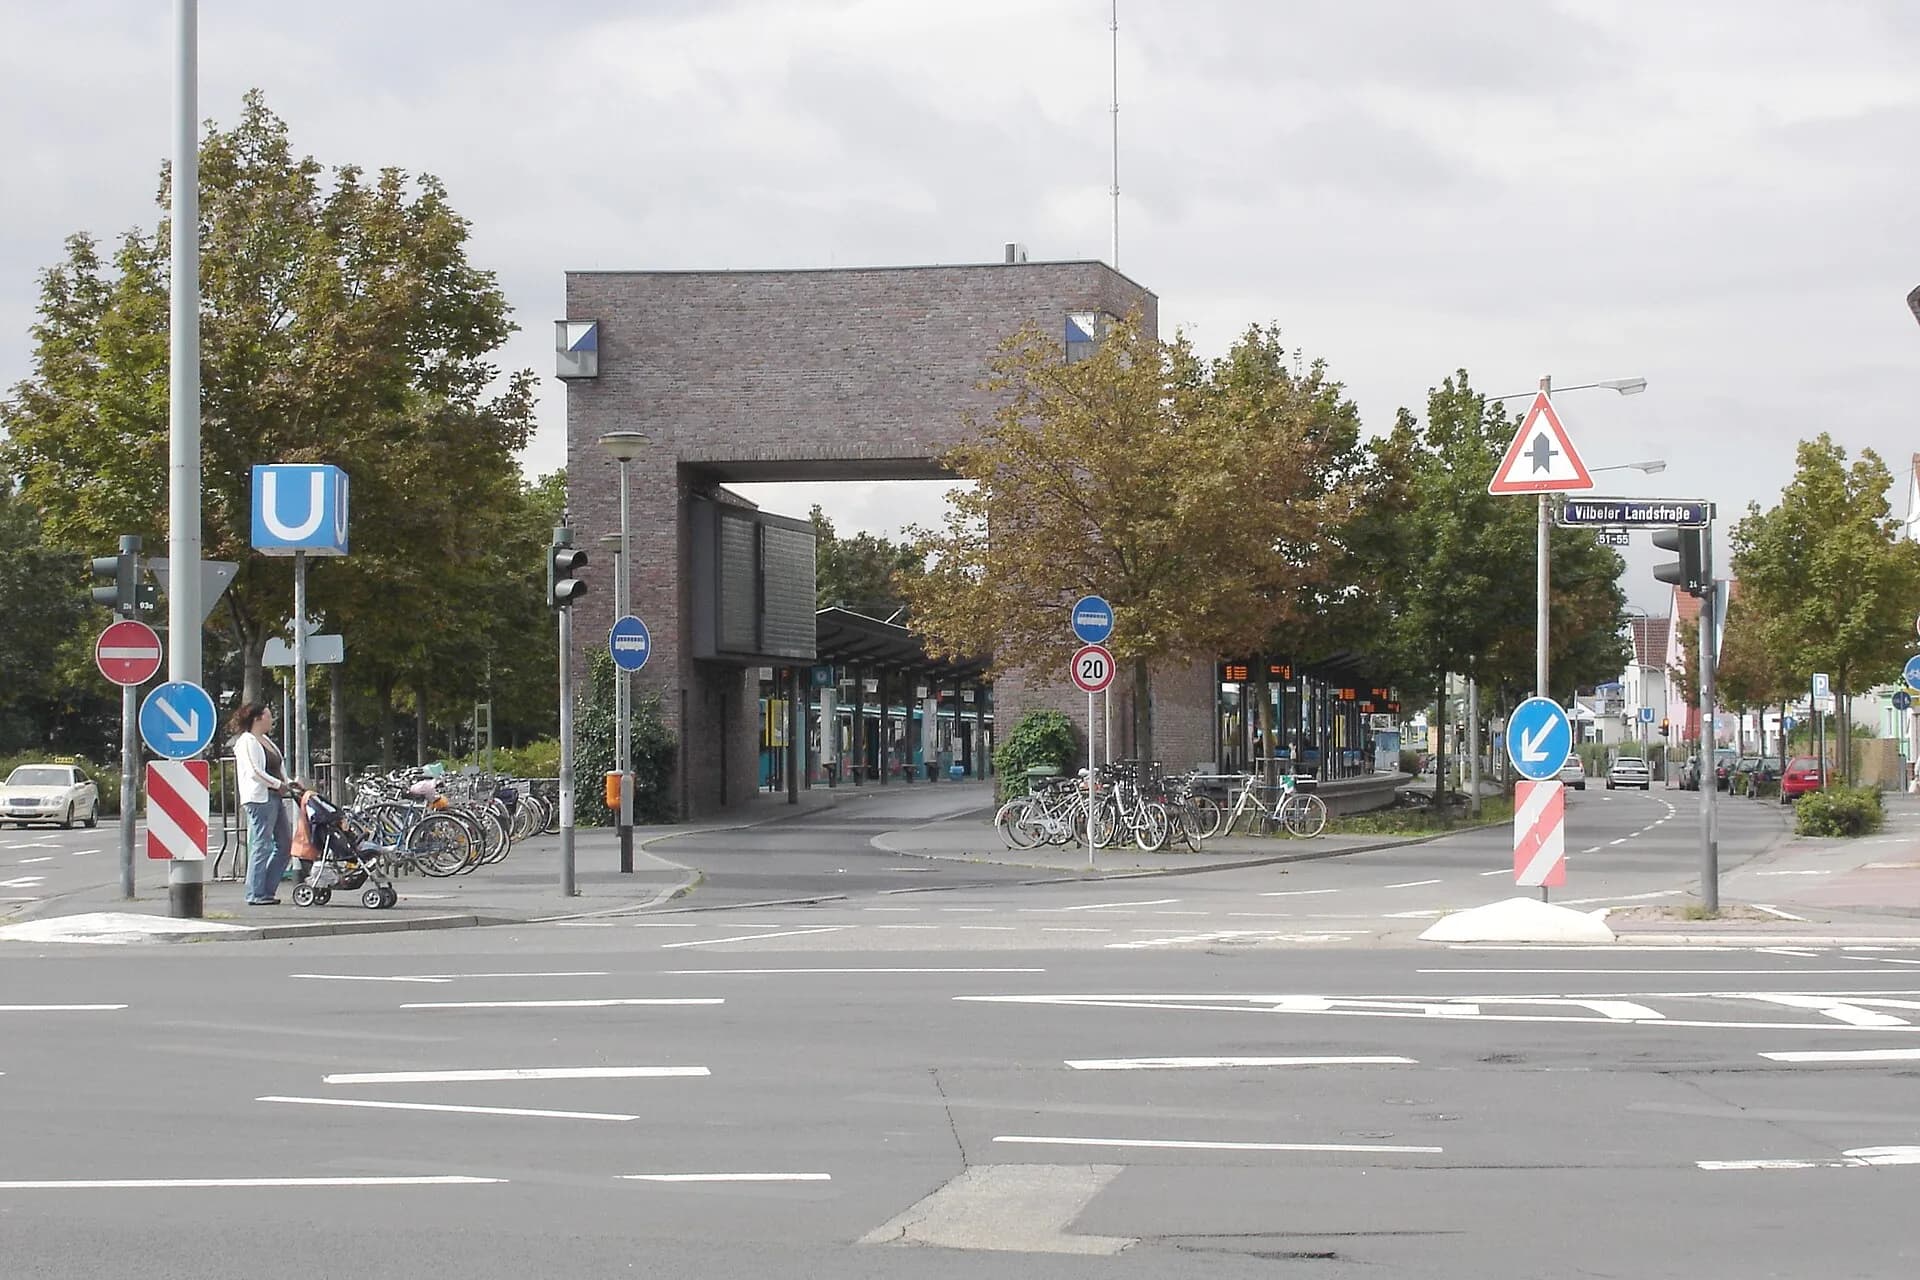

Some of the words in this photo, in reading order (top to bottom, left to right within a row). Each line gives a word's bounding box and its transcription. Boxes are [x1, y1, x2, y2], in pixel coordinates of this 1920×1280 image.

[262, 471, 325, 541] U
[1575, 505, 1619, 521] Vilbeler
[1624, 505, 1690, 522] Landstraße
[1599, 534, 1629, 545] 51-55
[1082, 660, 1103, 679] 20
[1816, 676, 1826, 695] P
[1641, 709, 1653, 721] U
